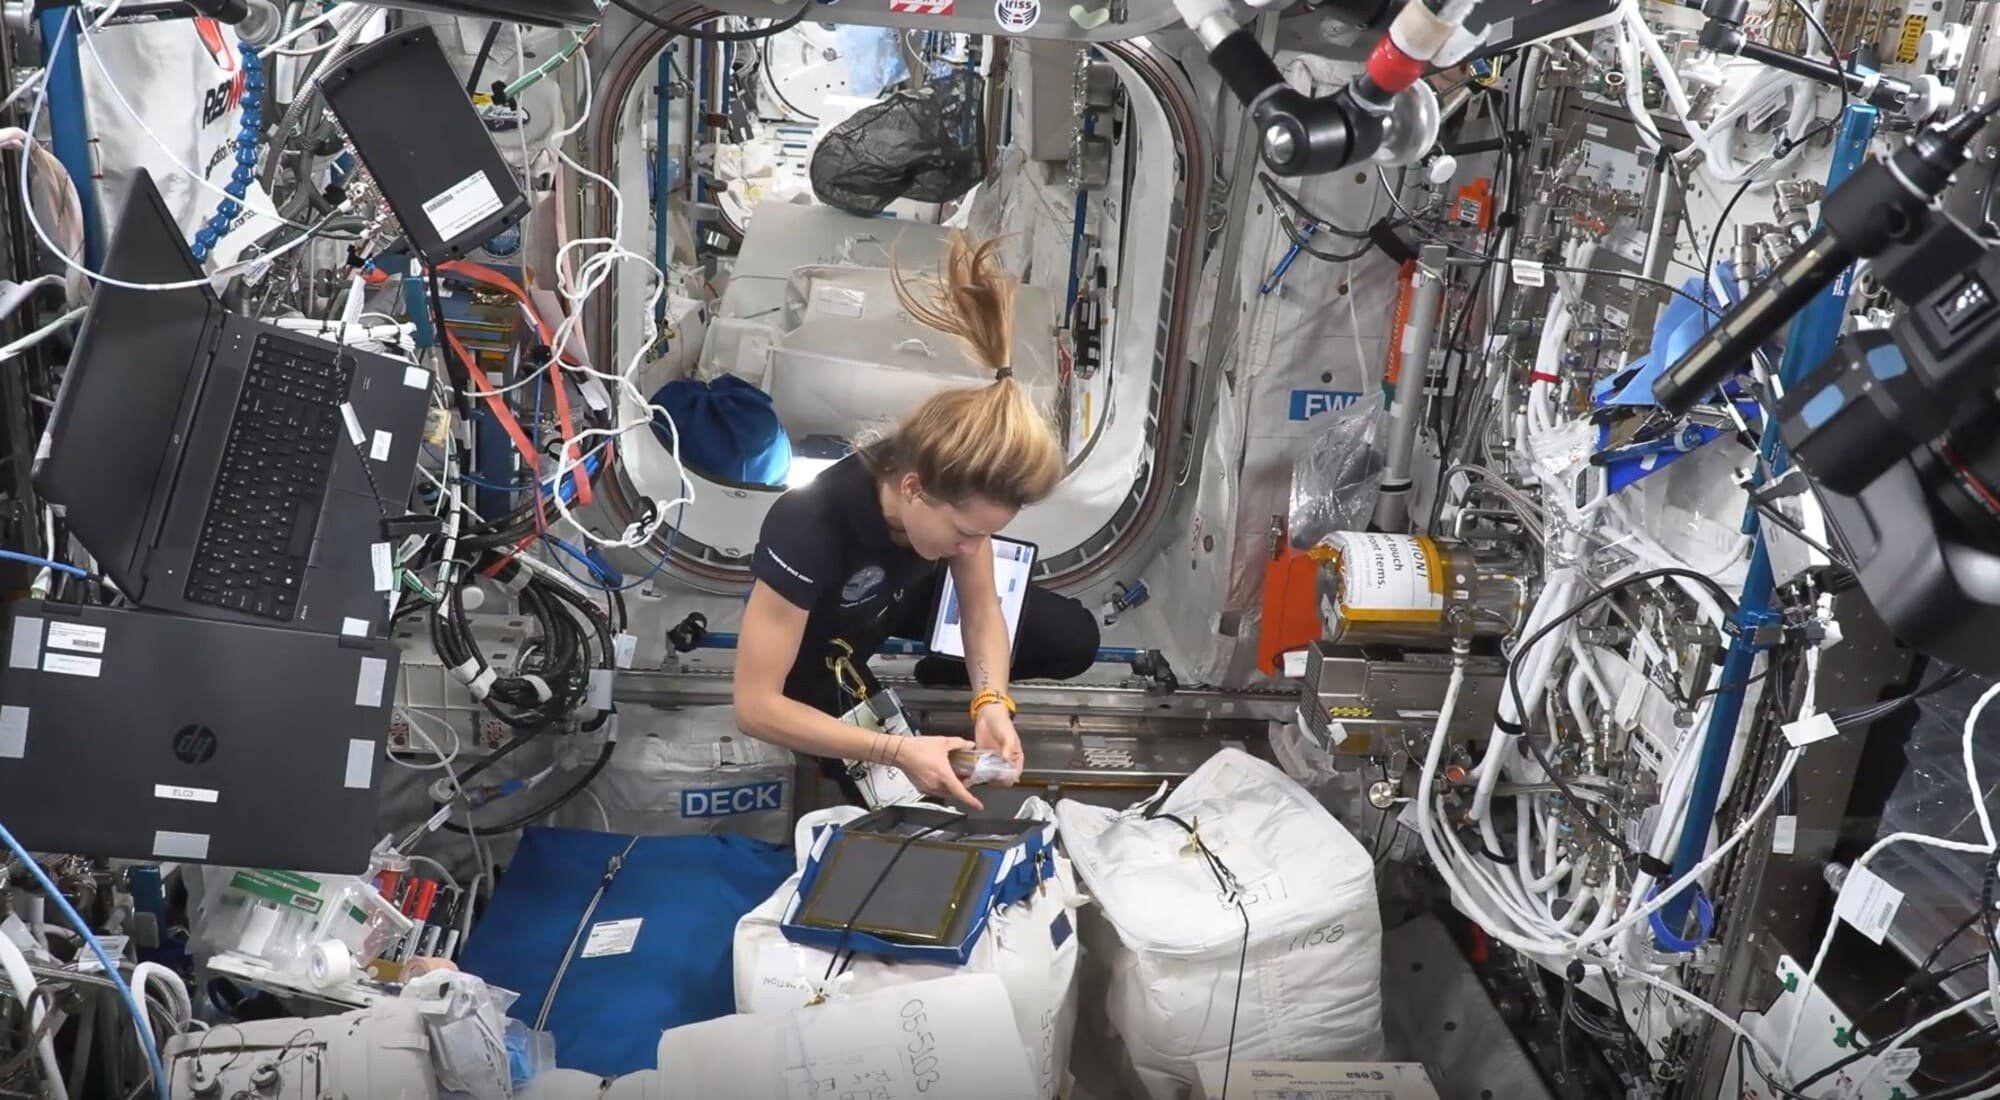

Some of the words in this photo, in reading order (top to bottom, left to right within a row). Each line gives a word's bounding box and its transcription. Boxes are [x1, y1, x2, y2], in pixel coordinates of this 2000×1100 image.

[1304, 393, 1361, 419] FW
[1375, 553, 1386, 590] items.
[1387, 543, 1404, 571] touch
[1408, 538, 1428, 578] TION!
[685, 784, 778, 816] DECK
[900, 998, 940, 1094] 05-5103
